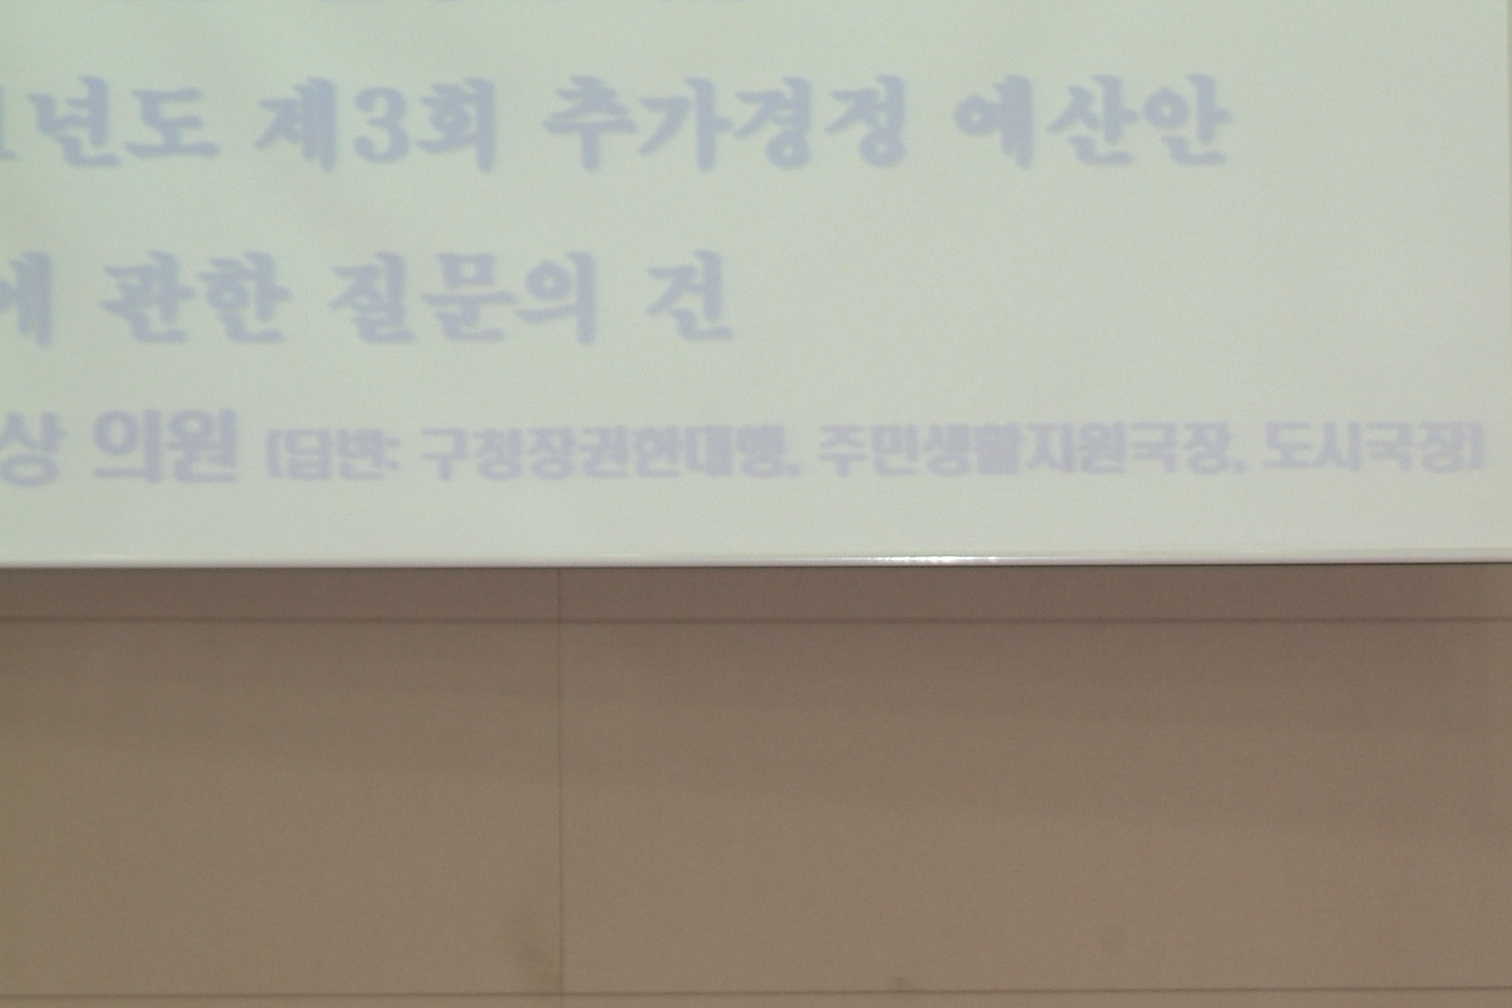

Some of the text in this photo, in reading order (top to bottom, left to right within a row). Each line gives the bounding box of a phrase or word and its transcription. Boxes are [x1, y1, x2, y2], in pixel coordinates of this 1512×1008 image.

[256, 77, 496, 172] 제3회
[543, 75, 906, 172] 추가경정
[953, 74, 1232, 169] 예산안
[99, 251, 291, 344] 관한
[329, 251, 597, 346] 질문의
[646, 250, 734, 342] 건
[0, 412, 66, 488] 상
[92, 409, 238, 483] 의원
